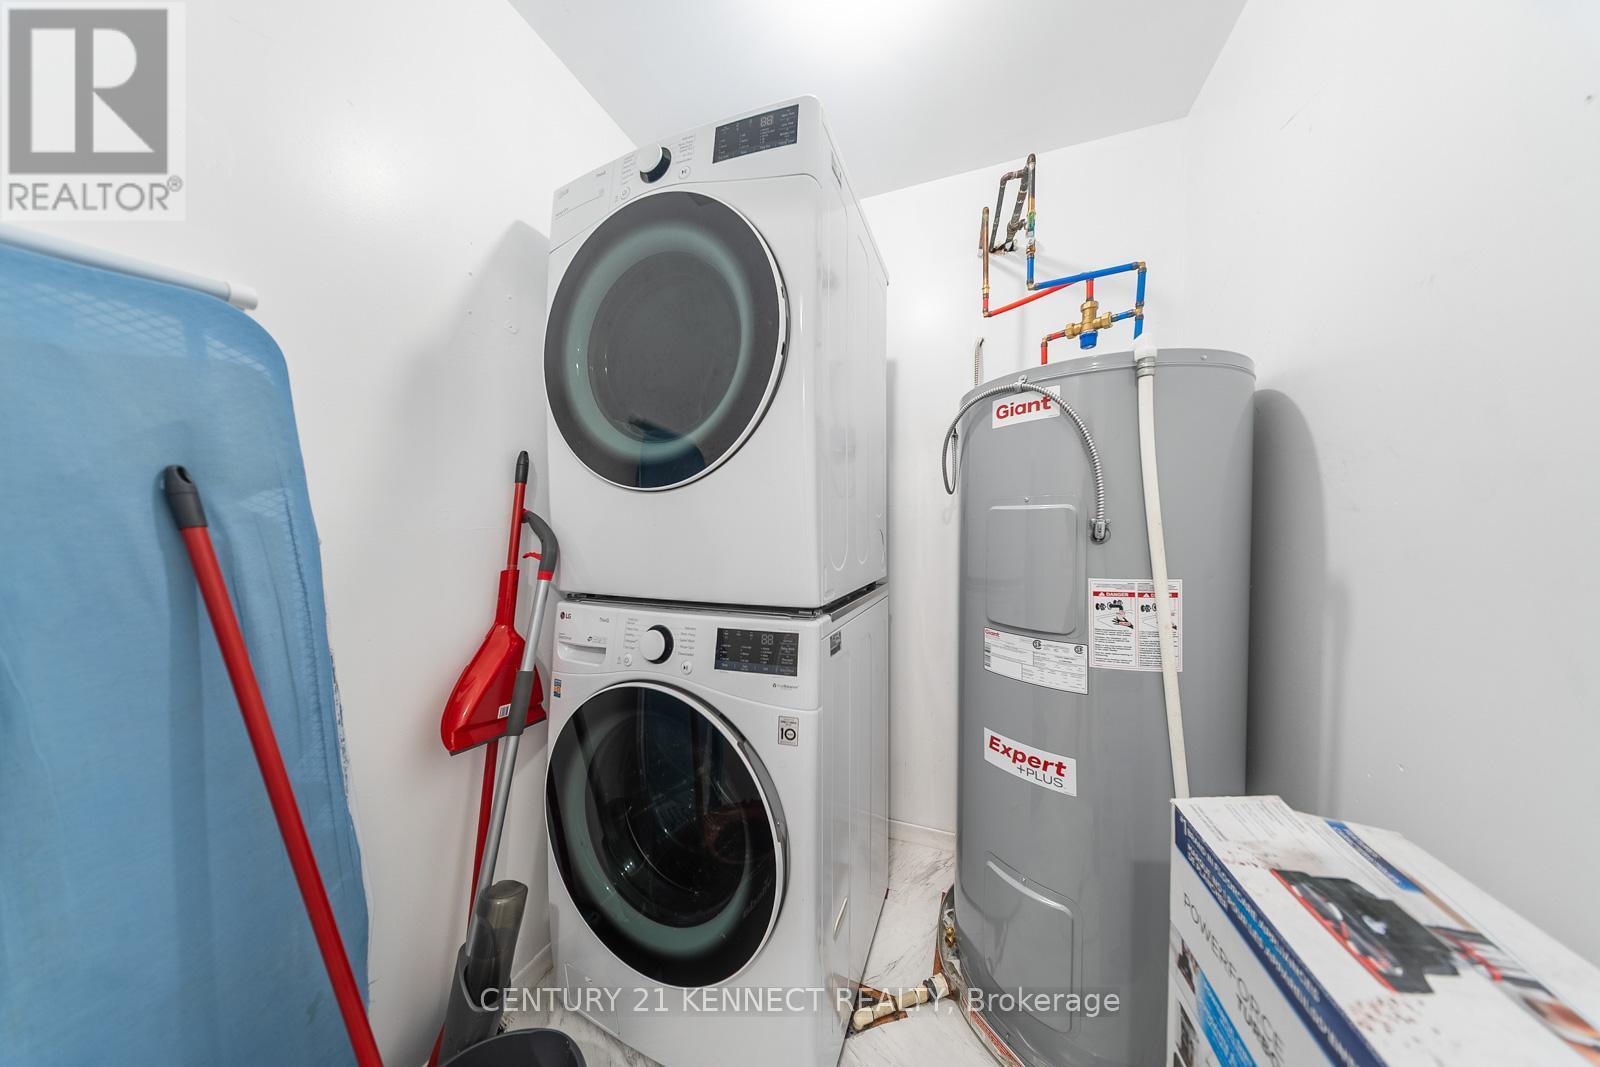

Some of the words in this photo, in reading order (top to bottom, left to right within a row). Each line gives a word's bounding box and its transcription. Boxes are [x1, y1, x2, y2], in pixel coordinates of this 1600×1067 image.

[996, 394, 1051, 419] Giant
[780, 727, 797, 741] 10
[989, 735, 1067, 777] Expert
[1017, 764, 1064, 788] +PLUS
[1183, 892, 1285, 1054] POWERFORCE
